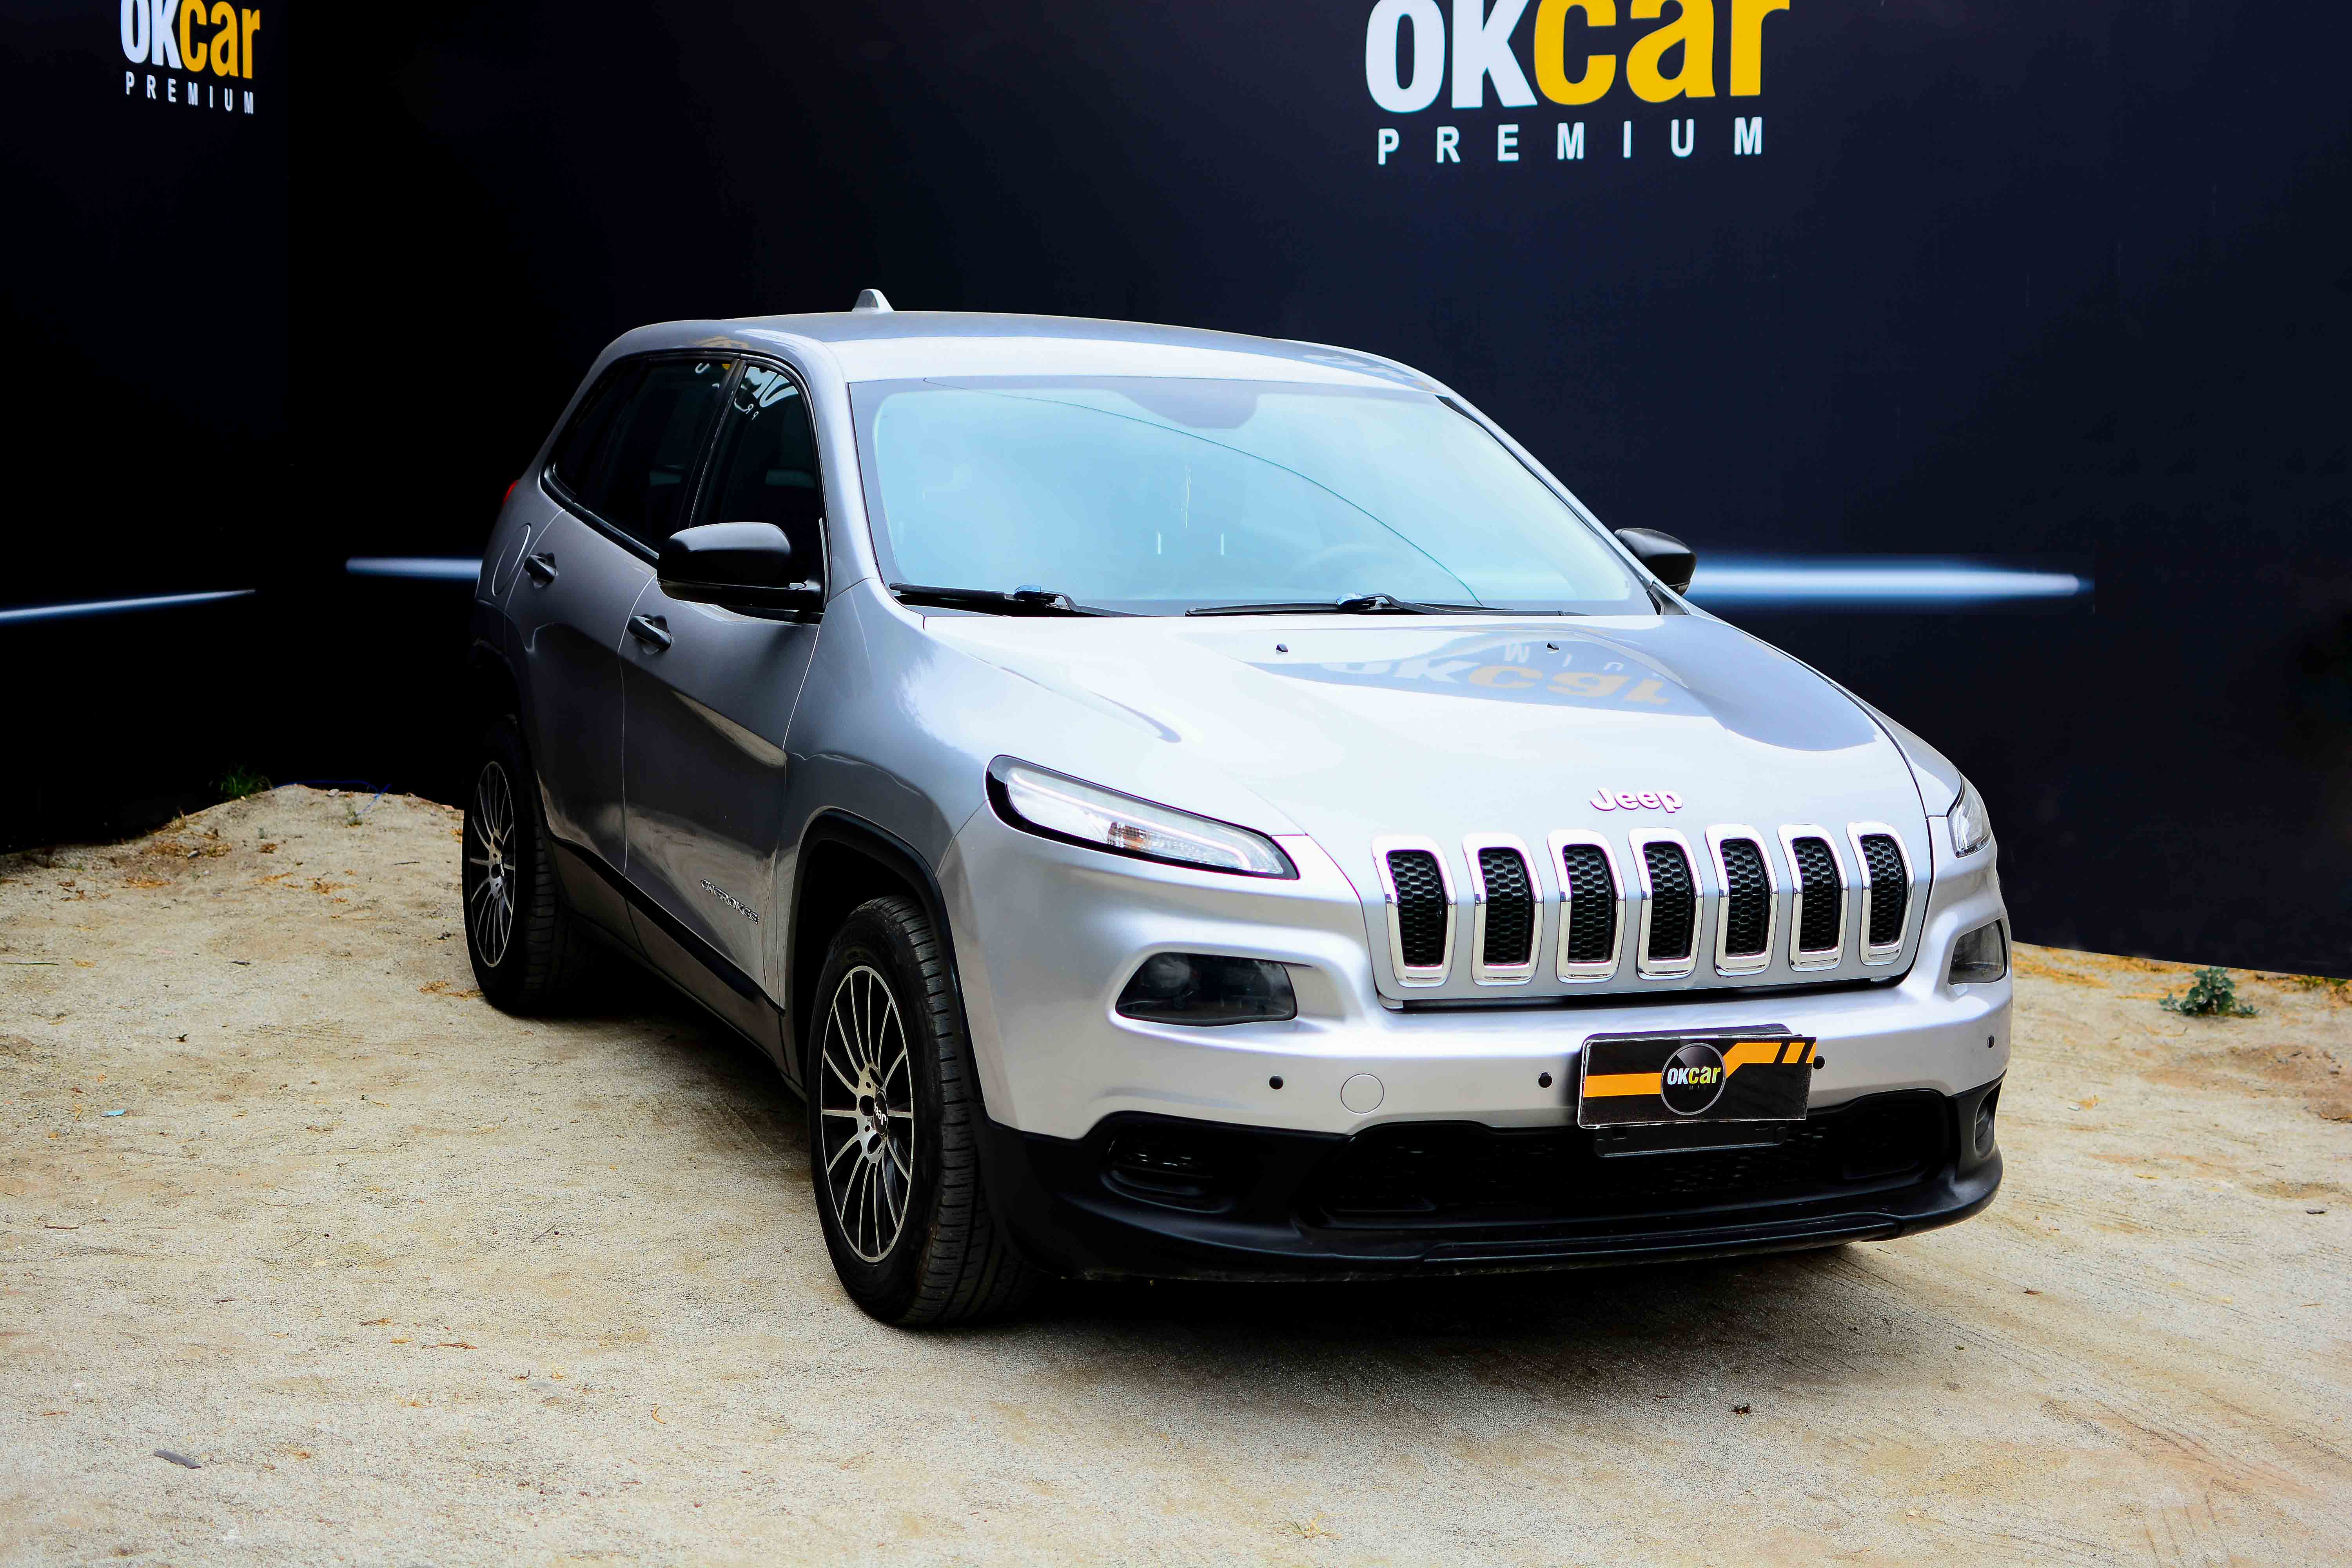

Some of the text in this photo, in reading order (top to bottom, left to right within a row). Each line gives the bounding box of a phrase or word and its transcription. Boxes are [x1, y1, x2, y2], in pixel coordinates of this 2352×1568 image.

[125, 71, 254, 114] PREMIUM
[1378, 116, 1762, 165] PREMIUM
[1590, 787, 1683, 813] Jeep
[873, 1101, 887, 1125] Jeep
